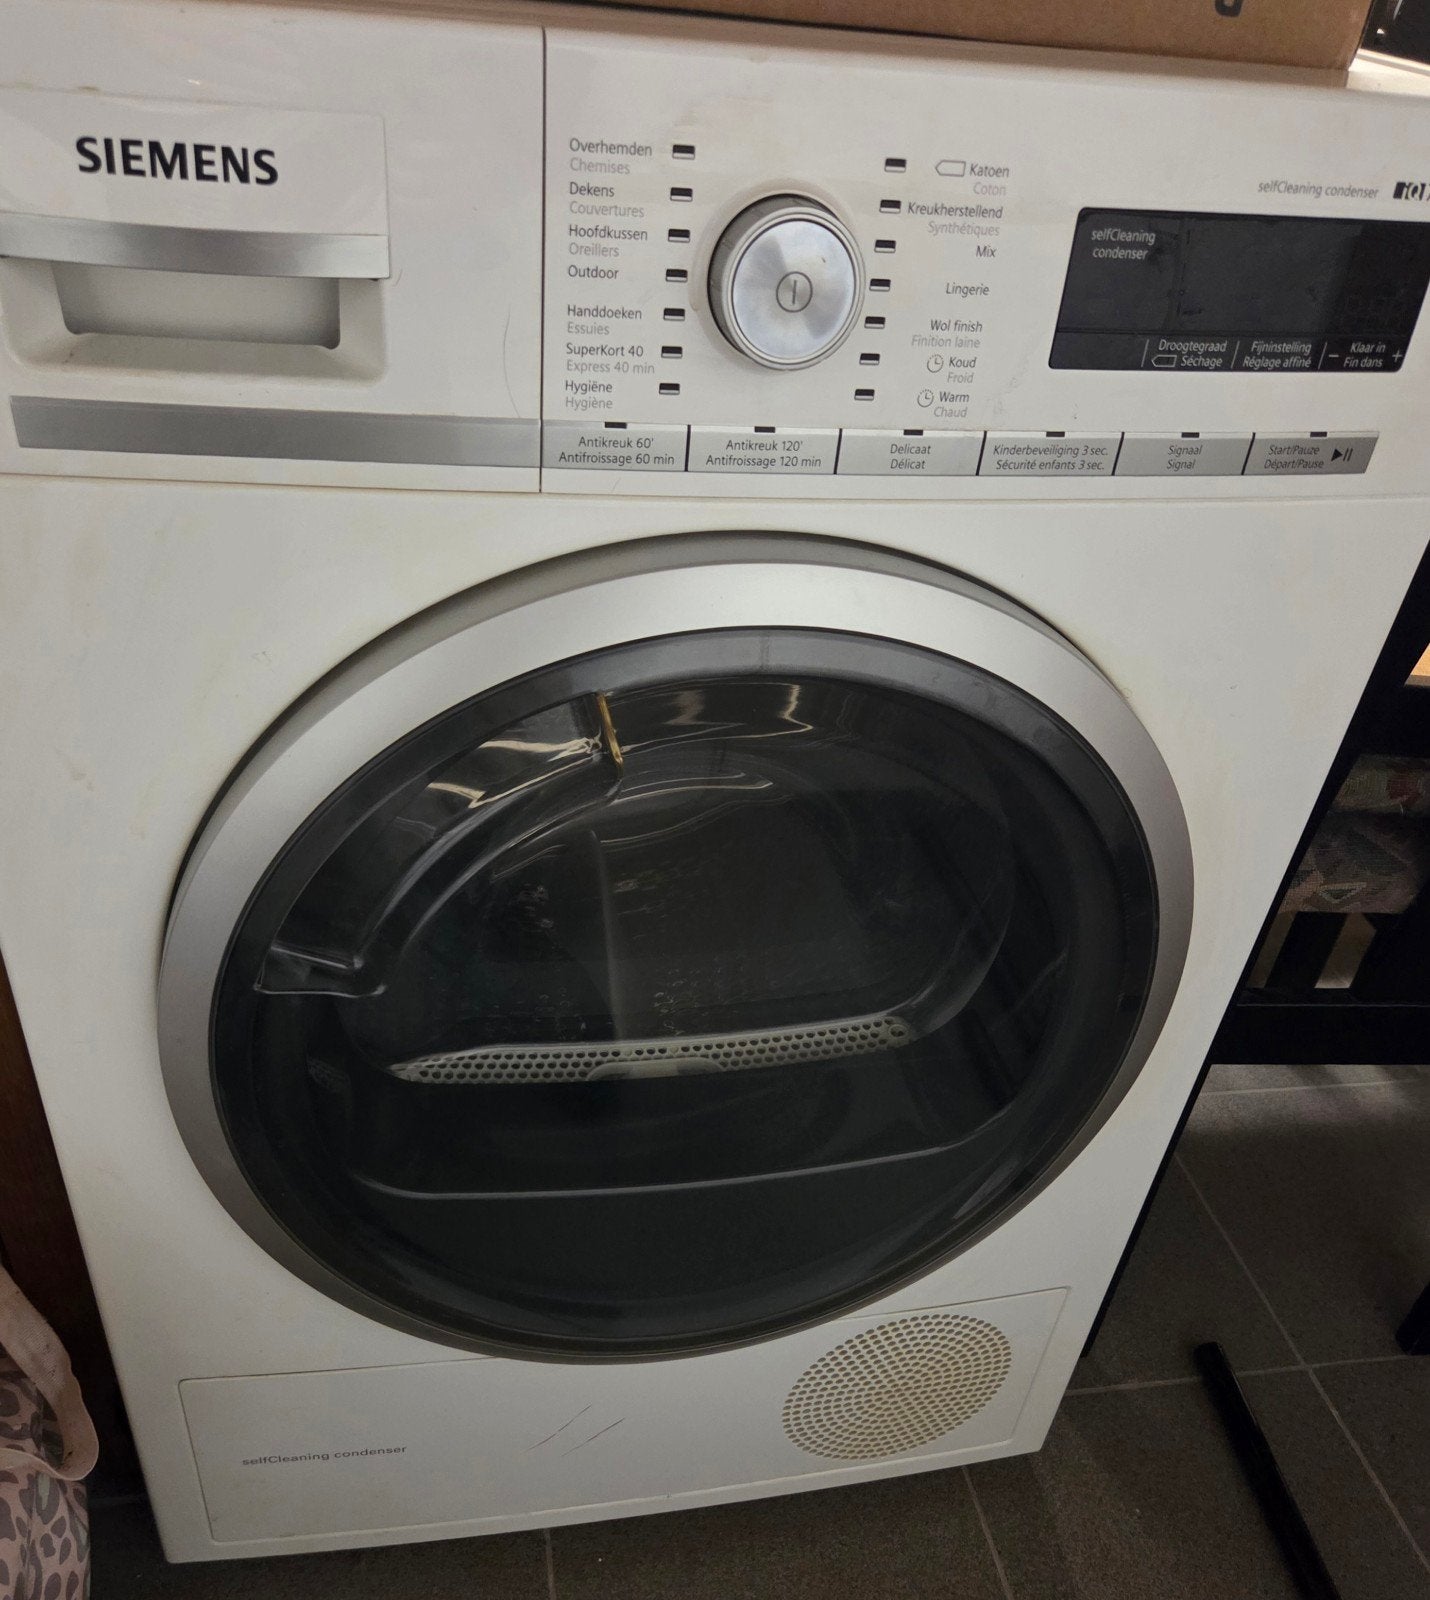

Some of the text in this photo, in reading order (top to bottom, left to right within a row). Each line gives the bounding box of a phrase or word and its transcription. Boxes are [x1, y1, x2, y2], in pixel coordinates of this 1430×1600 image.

[569, 137, 652, 156] Overhemden
[76, 136, 279, 186] SIEMENS
[570, 157, 630, 175] Chemises
[970, 163, 1010, 178] Katoen
[569, 181, 615, 197] Dekens
[973, 182, 1006, 196] Coton
[1257, 180, 1380, 199] selfCleaning condenser
[569, 200, 645, 218] Couvertures
[908, 202, 1003, 219] Kreukherstellend
[569, 224, 648, 241] Hoofdkussen
[928, 220, 1000, 238] Synthétiques
[1091, 228, 1156, 245] selfCleaning
[569, 242, 620, 258] Oreillers
[976, 245, 997, 258] Mix
[1092, 246, 1149, 261] condenser
[568, 264, 619, 280] Outdoor
[946, 282, 990, 298] Lingerie
[567, 304, 642, 320] Handdoeken
[567, 322, 610, 336] Essuies
[930, 319, 983, 333] Wol finish
[911, 334, 981, 348] Finition laine
[1158, 339, 1227, 354] Droogtegraad
[1251, 340, 1312, 356] Fijninstelling
[1350, 342, 1386, 354] Klaar in
[566, 342, 644, 358] SuperKort 40
[566, 360, 655, 374] Express 40 min
[949, 356, 977, 368] Koud
[1180, 354, 1223, 368] Séchage
[1243, 354, 1311, 368] Réglage affiné
[1344, 356, 1383, 368] Fin dans
[947, 372, 975, 384] Froid
[565, 380, 613, 395] Hygiëne
[565, 396, 613, 412] Hygiène
[939, 391, 970, 403] Warm
[934, 406, 968, 418] Chaud
[578, 436, 654, 449] Antikreuk 60'
[726, 439, 803, 452] Antikreuk 120'
[890, 444, 931, 455] Delicaat
[558, 451, 675, 465] Antifroissage 60 min
[993, 444, 1109, 458] Kinderbeveiliging 3 sec.
[1167, 445, 1203, 458] Signaal
[706, 454, 822, 468] Antifroissage 120 min
[890, 457, 926, 470] Délicat
[996, 458, 1105, 471] Sécurité enfants 3 sec.
[1166, 458, 1196, 472] Signal
[1264, 458, 1325, 471] Départ/Pause
[242, 1446, 408, 1466] selfCleaning condenser
